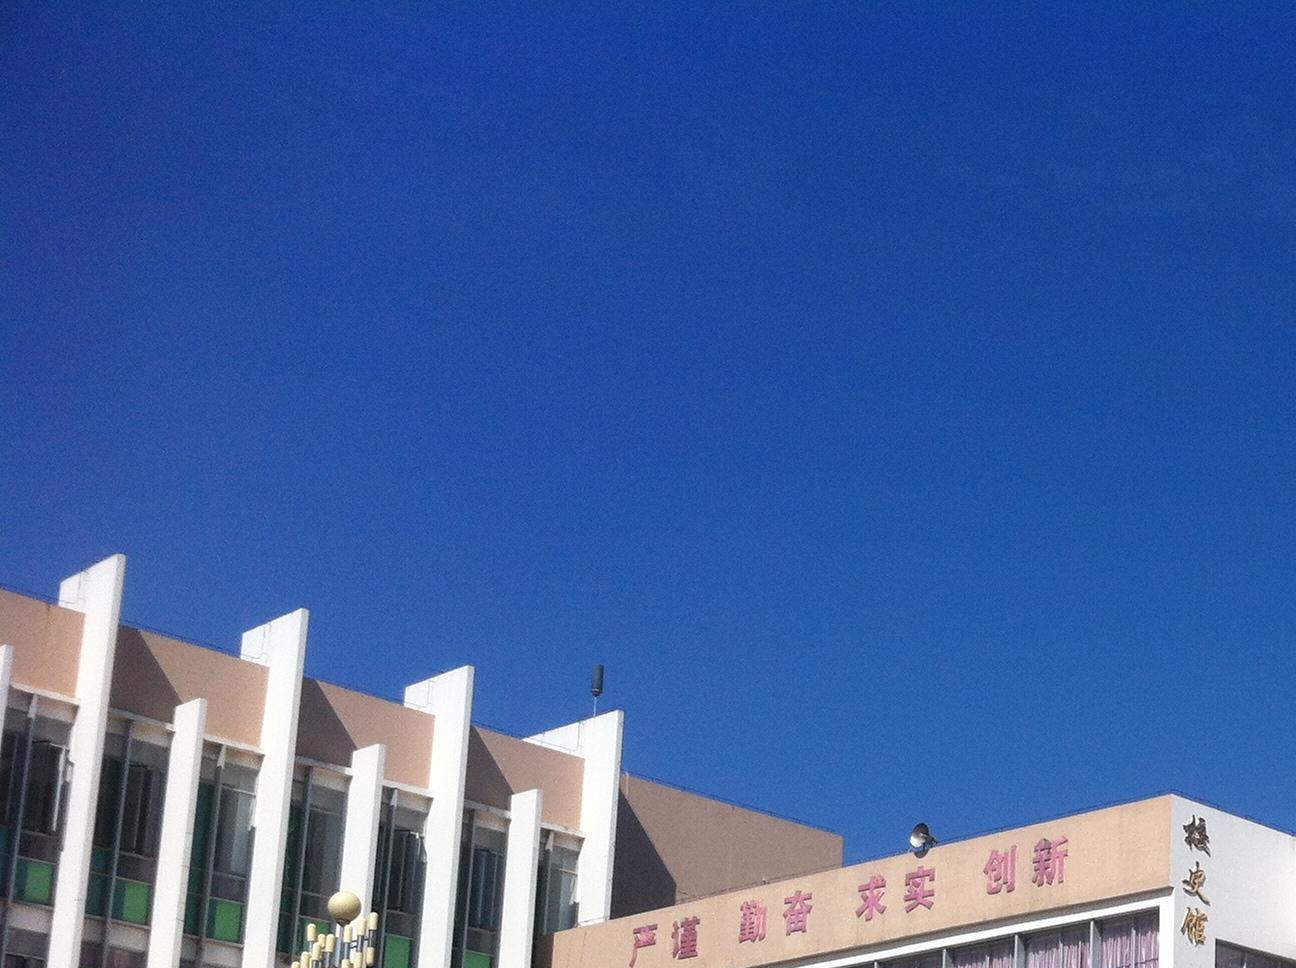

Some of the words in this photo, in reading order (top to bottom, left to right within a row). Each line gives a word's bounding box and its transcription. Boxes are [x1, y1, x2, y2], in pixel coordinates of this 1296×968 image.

[628, 914, 701, 968] 严谨
[738, 889, 813, 944] 勤奋
[855, 865, 937, 922] 求实
[983, 835, 1069, 895] 创新
